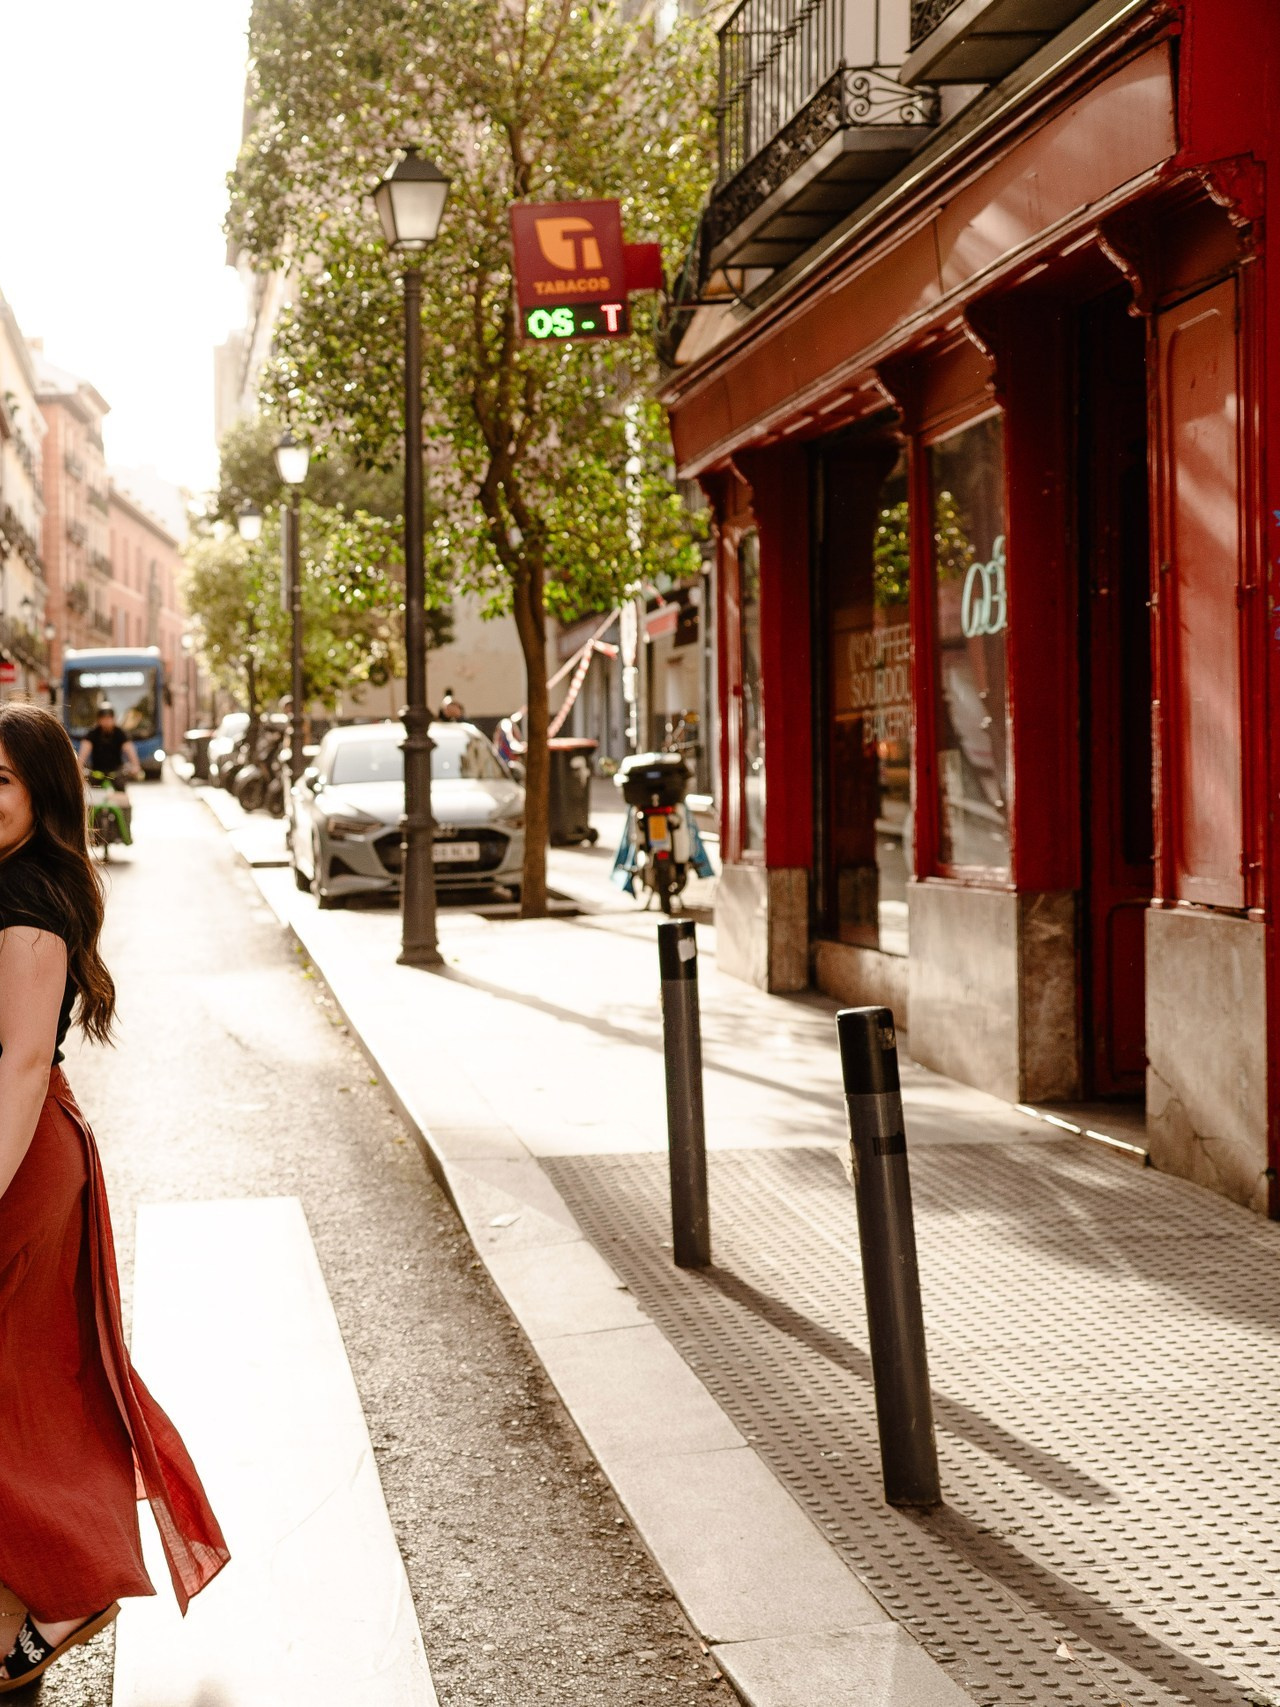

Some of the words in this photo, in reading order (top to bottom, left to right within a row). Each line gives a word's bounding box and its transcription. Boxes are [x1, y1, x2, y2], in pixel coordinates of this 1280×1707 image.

[534, 277, 610, 295] TABACOS
[527, 308, 575, 339] OS
[601, 304, 622, 332] T
[18, 1623, 45, 1664] hloé
